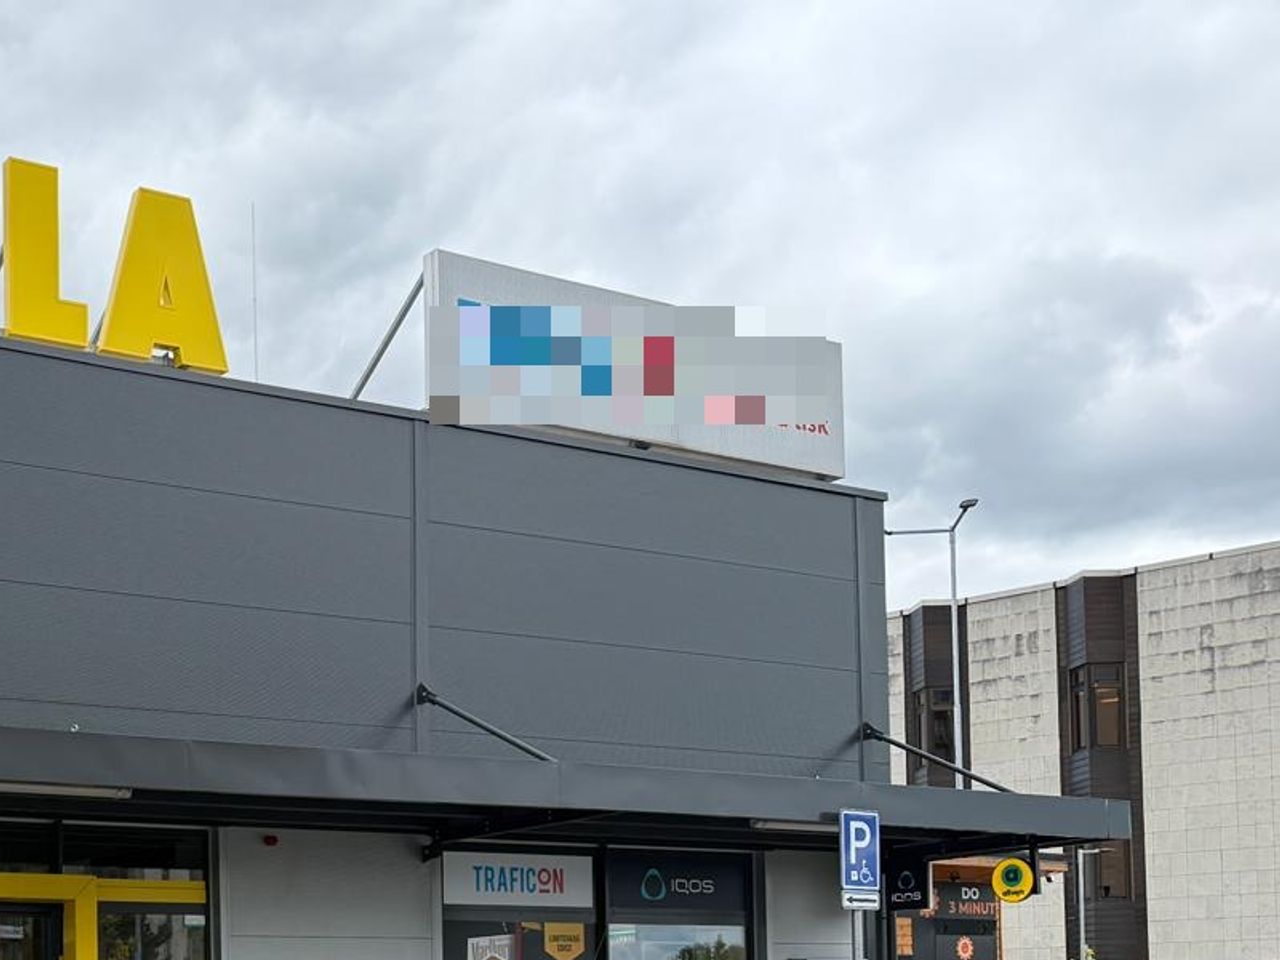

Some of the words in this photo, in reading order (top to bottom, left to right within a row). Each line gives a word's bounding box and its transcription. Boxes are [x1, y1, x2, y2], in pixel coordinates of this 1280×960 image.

[849, 820, 871, 864] P
[473, 865, 565, 894] TRAFICON
[670, 878, 715, 894] IQOS
[961, 887, 980, 900] DO
[948, 902, 956, 914] 3
